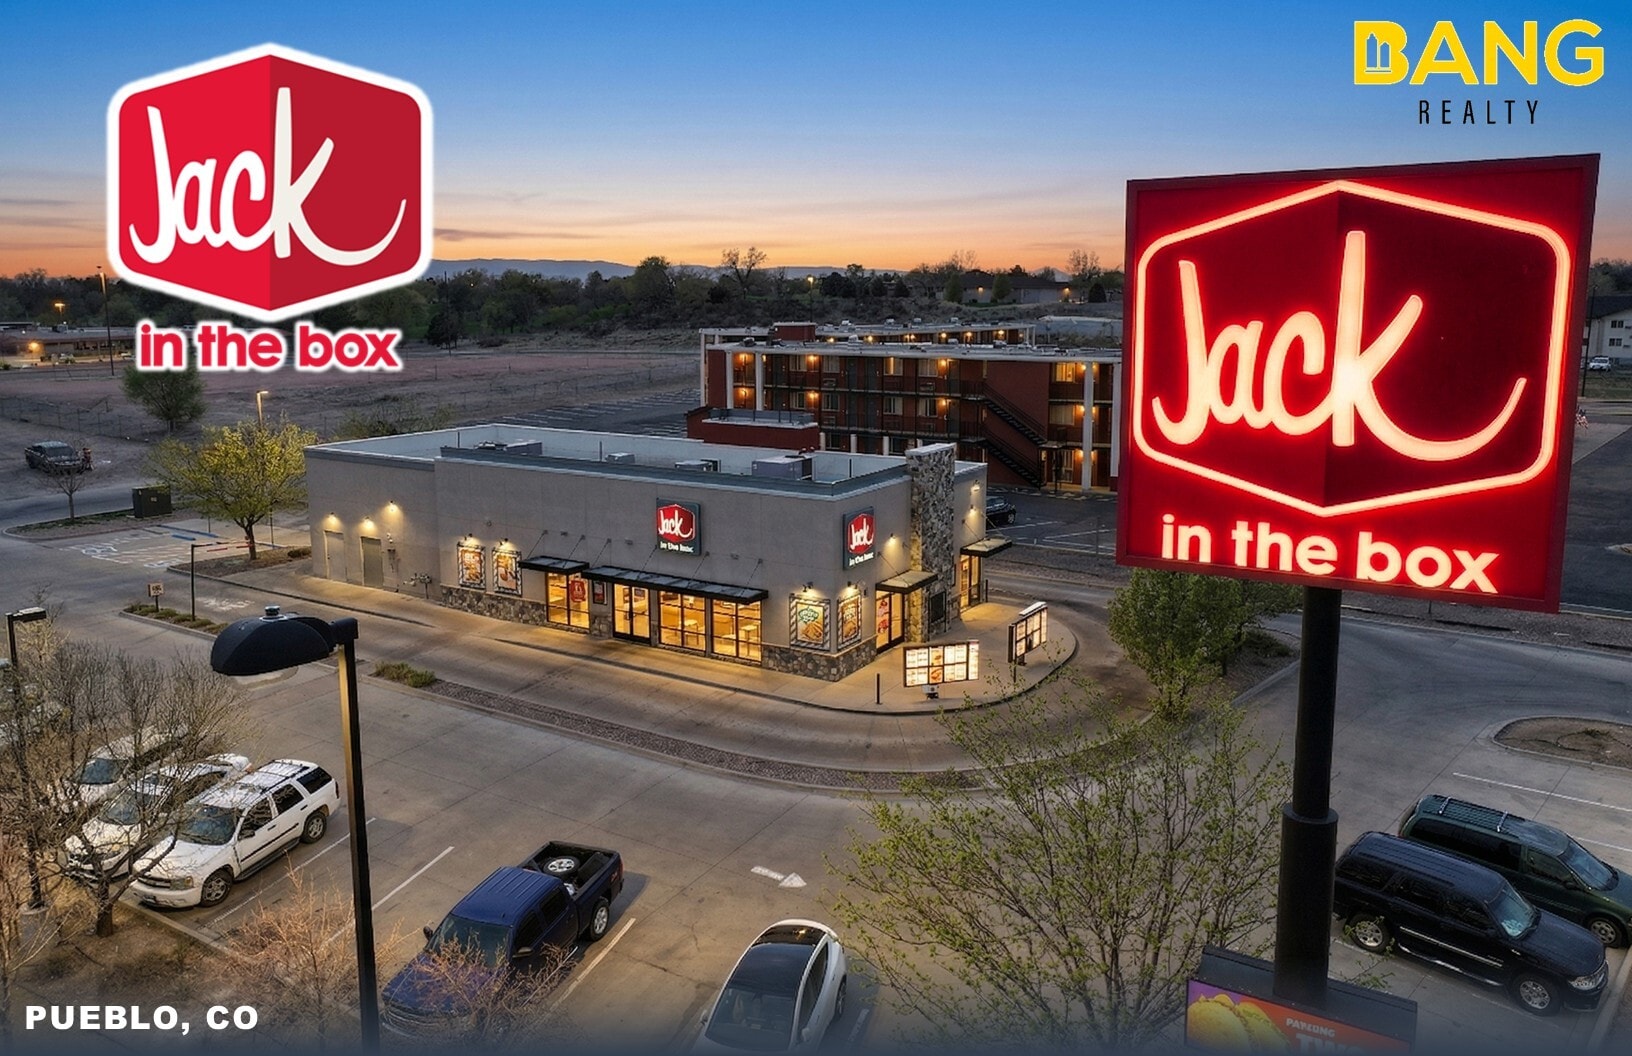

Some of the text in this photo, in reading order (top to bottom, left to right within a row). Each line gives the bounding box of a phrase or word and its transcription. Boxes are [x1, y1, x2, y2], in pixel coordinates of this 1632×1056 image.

[1151, 230, 1527, 462] Jack
[658, 510, 693, 538] Jack
[1161, 514, 1499, 594] in the box
